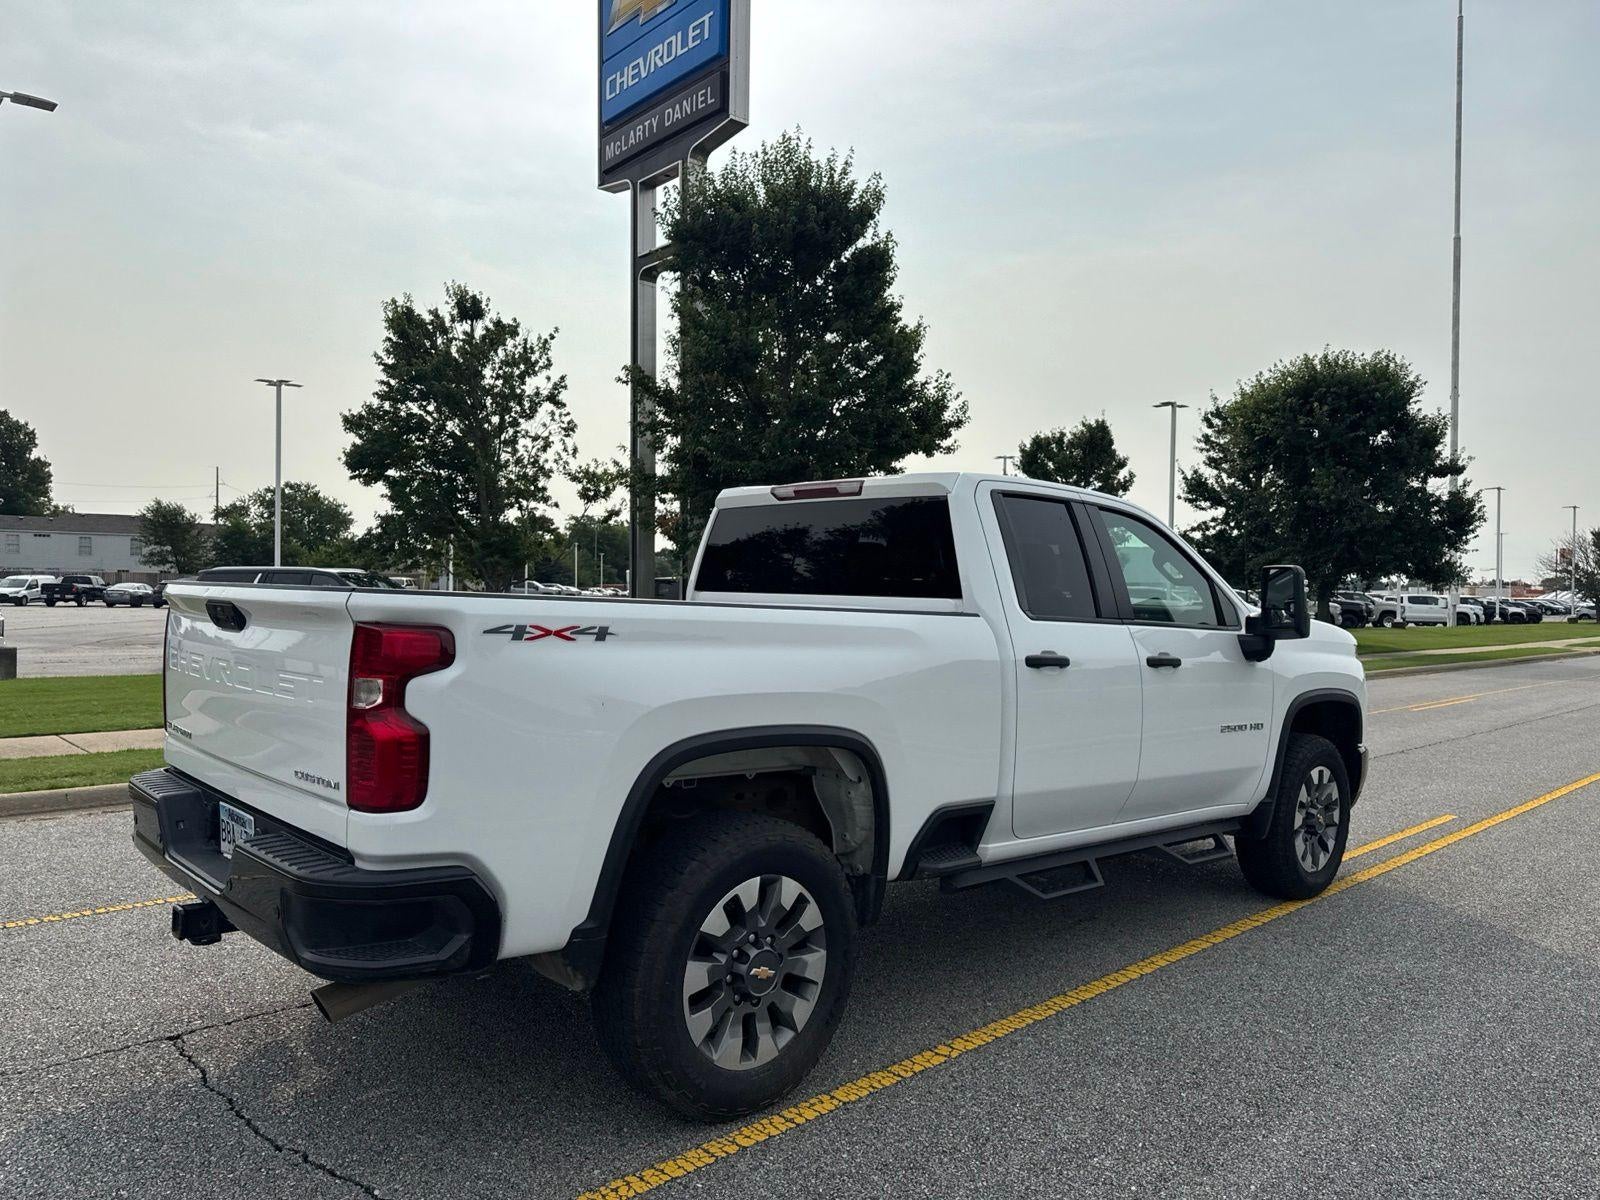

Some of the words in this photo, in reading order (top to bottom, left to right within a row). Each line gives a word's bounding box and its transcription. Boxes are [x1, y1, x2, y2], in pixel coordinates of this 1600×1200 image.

[606, 11, 714, 101] CHEVROLET
[605, 115, 659, 161] McLARTY
[664, 86, 715, 127] DANIEL
[168, 640, 324, 703] CHEVROLET
[1220, 724, 1248, 734] 2500
[1249, 722, 1264, 731] HD
[293, 769, 340, 791] CUSTOM
